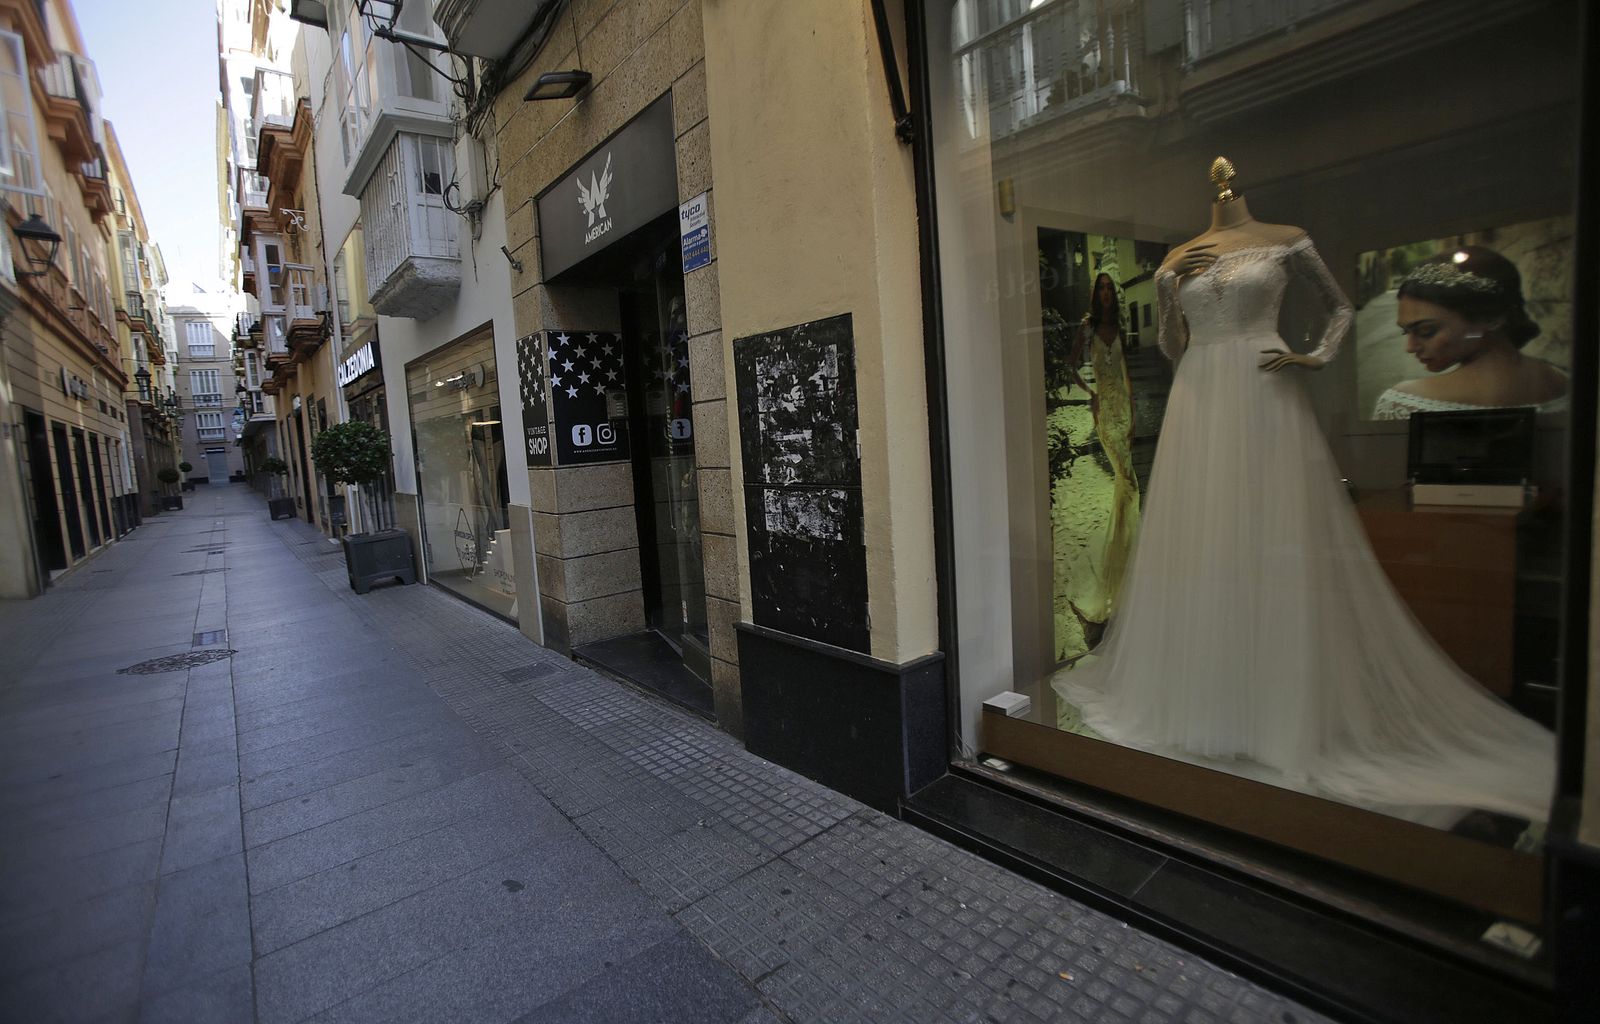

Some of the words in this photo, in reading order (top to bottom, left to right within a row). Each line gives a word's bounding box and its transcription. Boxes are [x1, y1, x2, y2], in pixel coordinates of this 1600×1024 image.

[681, 203, 700, 220] tyco
[585, 217, 612, 245] AMERICAN
[338, 342, 375, 387] CALZEDONIA
[527, 426, 547, 435] VINTAGE
[528, 437, 548, 455] SHOP
